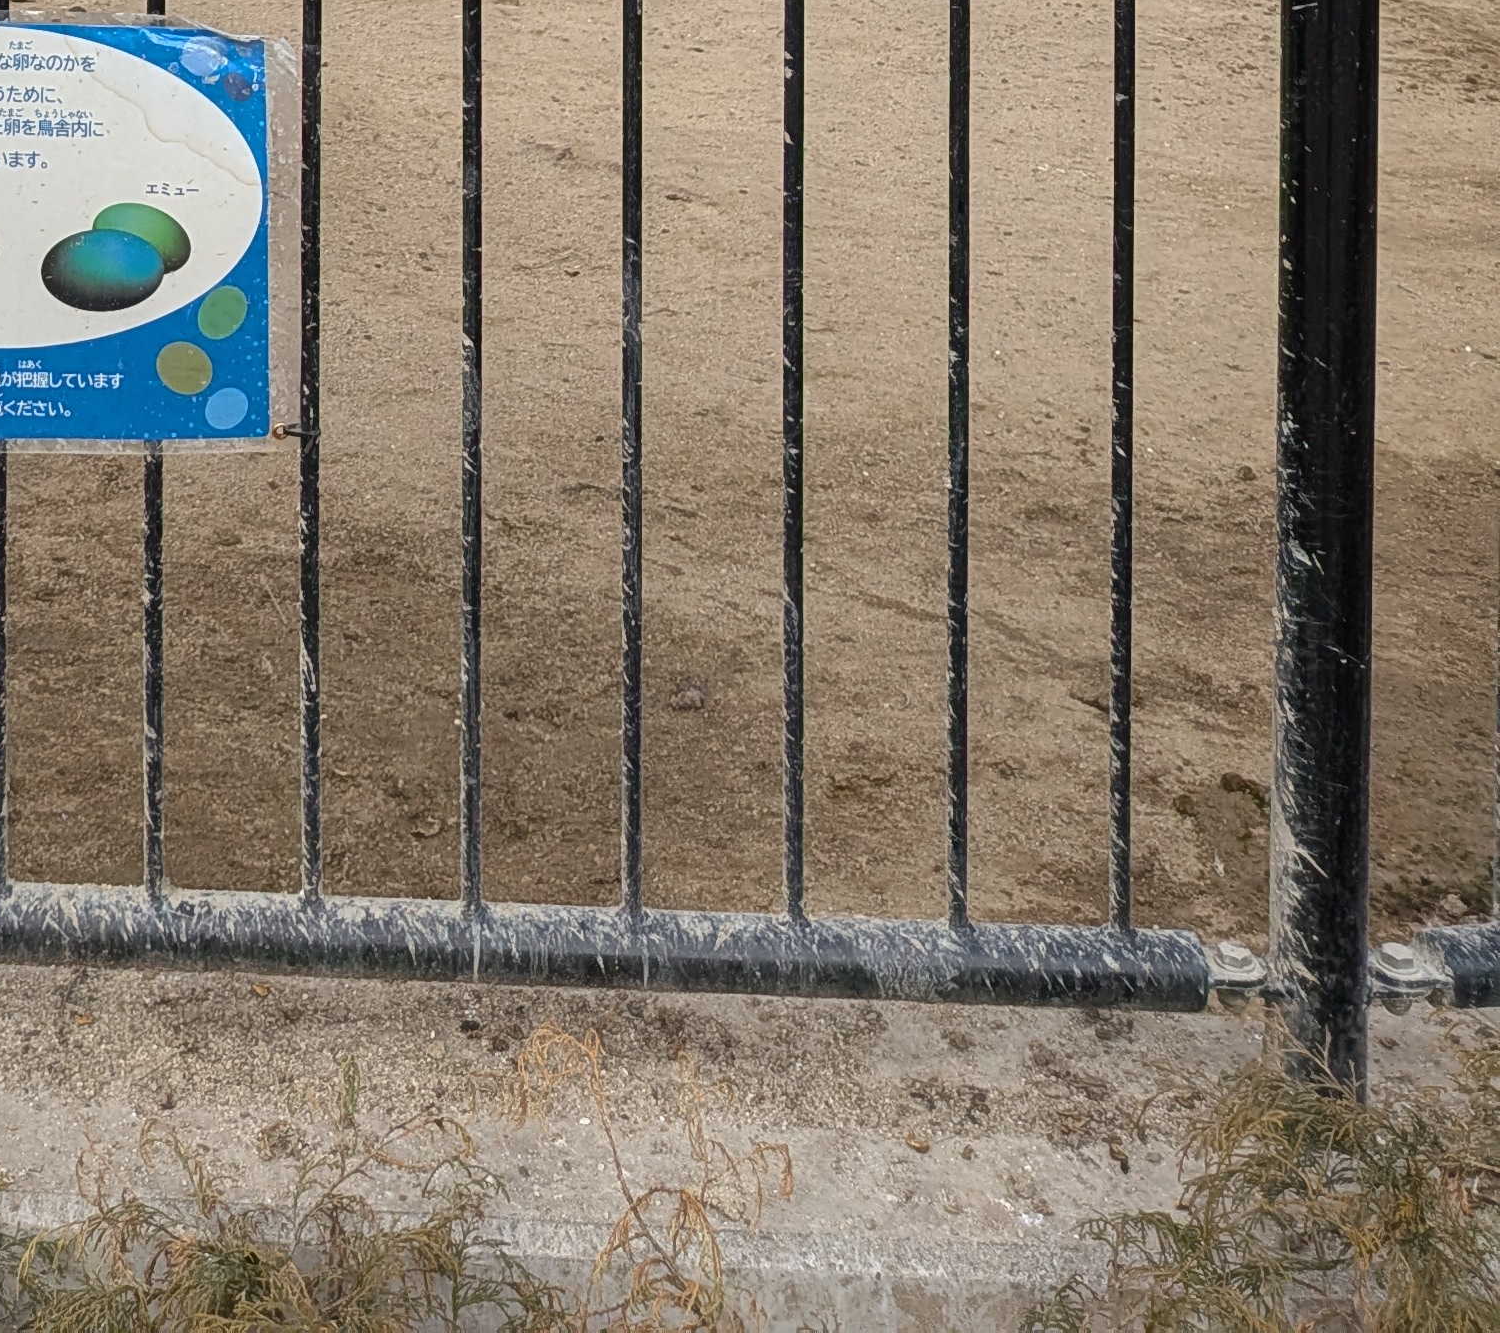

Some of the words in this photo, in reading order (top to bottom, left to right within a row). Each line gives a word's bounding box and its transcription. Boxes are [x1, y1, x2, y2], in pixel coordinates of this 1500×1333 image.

[8, 41, 33, 50] たまご
[0, 108, 24, 117] たまご
[34, 108, 93, 119] ちょうしゃない
[145, 183, 199, 196] エミュー
[18, 359, 42, 369] はあく
